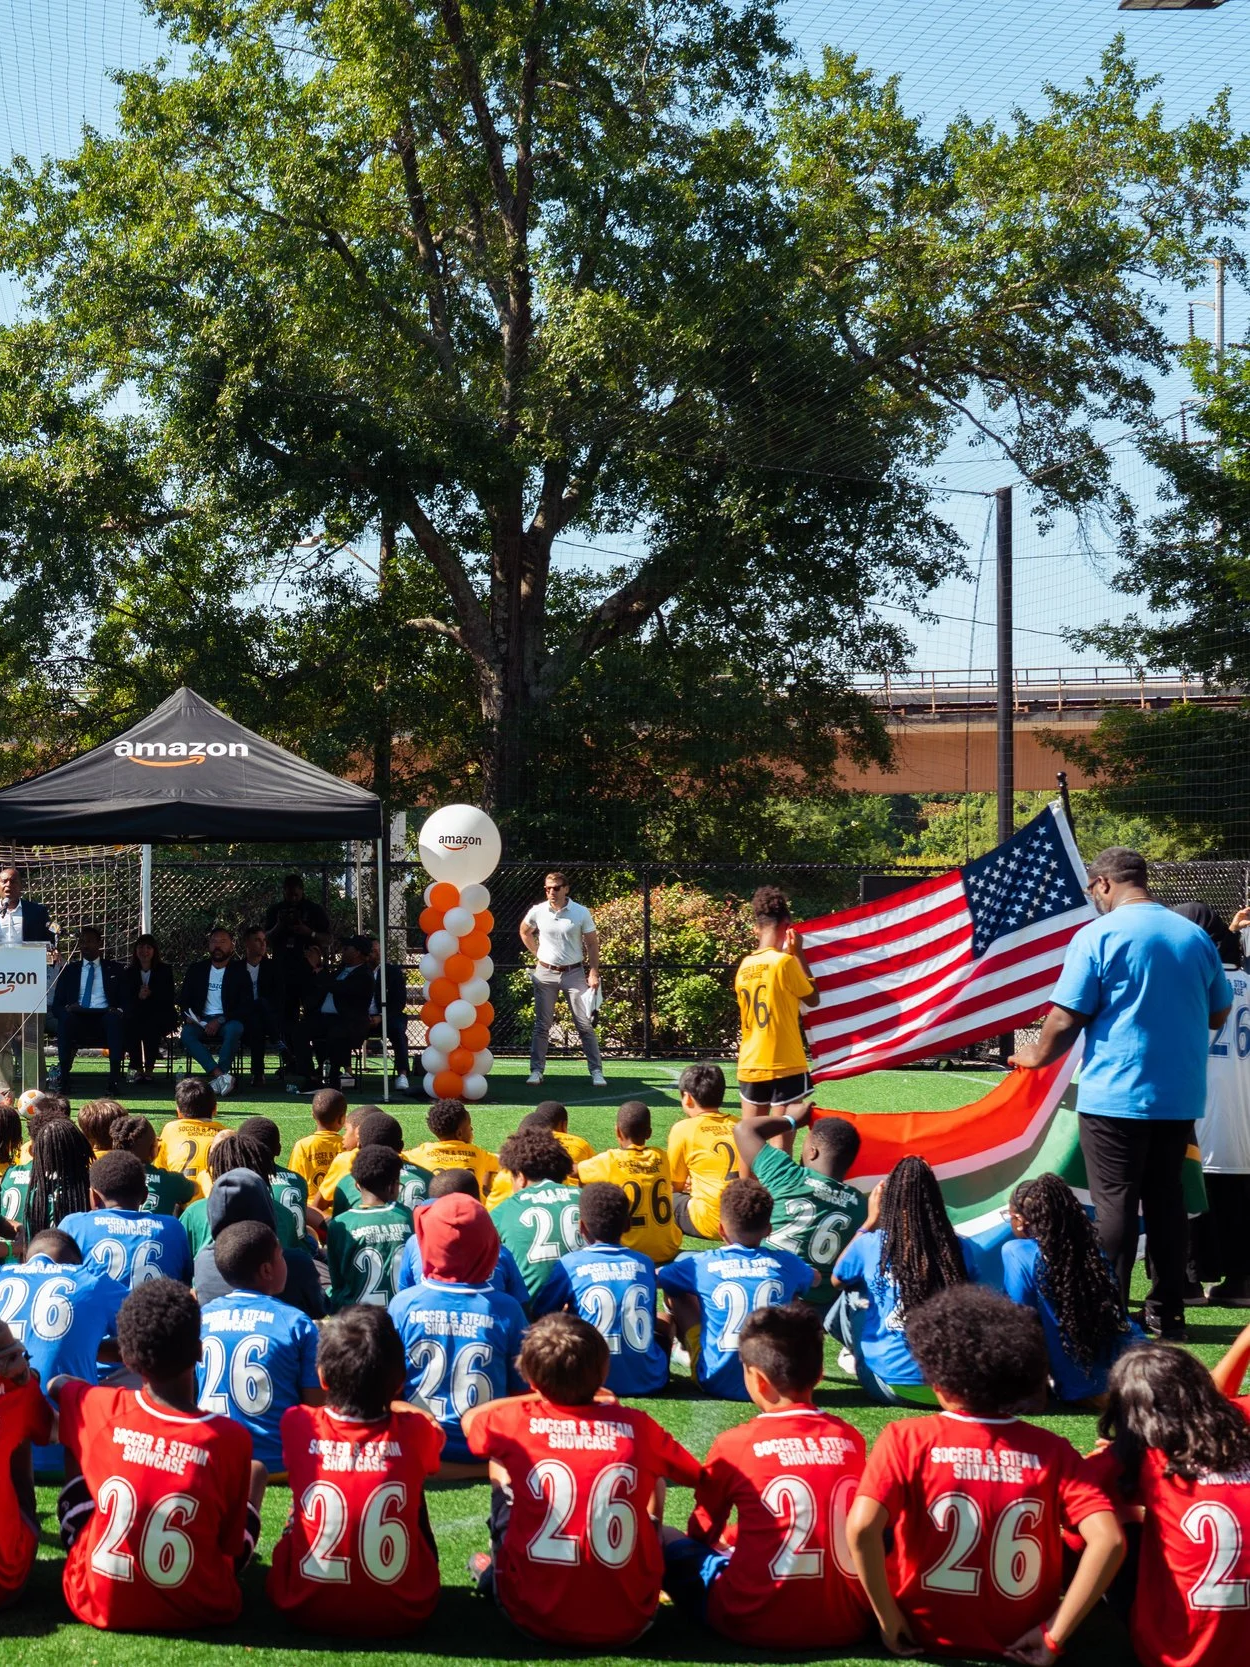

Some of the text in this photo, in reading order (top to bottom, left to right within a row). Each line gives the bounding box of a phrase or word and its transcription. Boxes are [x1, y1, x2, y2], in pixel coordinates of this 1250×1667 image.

[114, 741, 249, 758] amazon
[439, 835, 482, 847] amazon
[741, 983, 769, 1030] 26
[713, 1142, 739, 1181] 2
[144, 1174, 160, 1184] EAM
[280, 1187, 305, 1239] 6
[622, 1178, 672, 1229] 26
[94, 1216, 126, 1227] SOCCER
[137, 1218, 164, 1230] STEAM
[107, 1224, 152, 1236] SHOWCASE
[352, 1224, 380, 1240] SOCCER
[519, 1204, 587, 1264] 26
[765, 1197, 852, 1265] 26
[365, 1232, 404, 1244] SHOWCASE
[94, 1238, 163, 1290] 26
[242, 1309, 274, 1323] STEAM
[409, 1311, 494, 1329] SOCCER & STEAM
[581, 1284, 653, 1354] 26
[425, 1322, 478, 1338] SHOWCASE
[197, 1334, 273, 1416] 26
[408, 1339, 493, 1420] 26
[529, 1418, 634, 1439] SOCCER & STEAM
[113, 1427, 209, 1467] SOCCER & STEAM
[309, 1439, 402, 1457] SOCCER & STEAM
[548, 1434, 617, 1451] SHOWCASE
[753, 1438, 804, 1457] SOCCER
[805, 1437, 817, 1451] &
[122, 1446, 186, 1476] SHOWCASE
[322, 1454, 387, 1472] SHOWCASE
[779, 1449, 845, 1466] SHOWCASE
[931, 1446, 1041, 1470] SOCCER & STEAM
[953, 1463, 1024, 1484] SHOWCASE
[526, 1459, 638, 1569] 26
[91, 1475, 200, 1588] 26
[300, 1480, 410, 1585] 26
[921, 1491, 1044, 1600] 26
